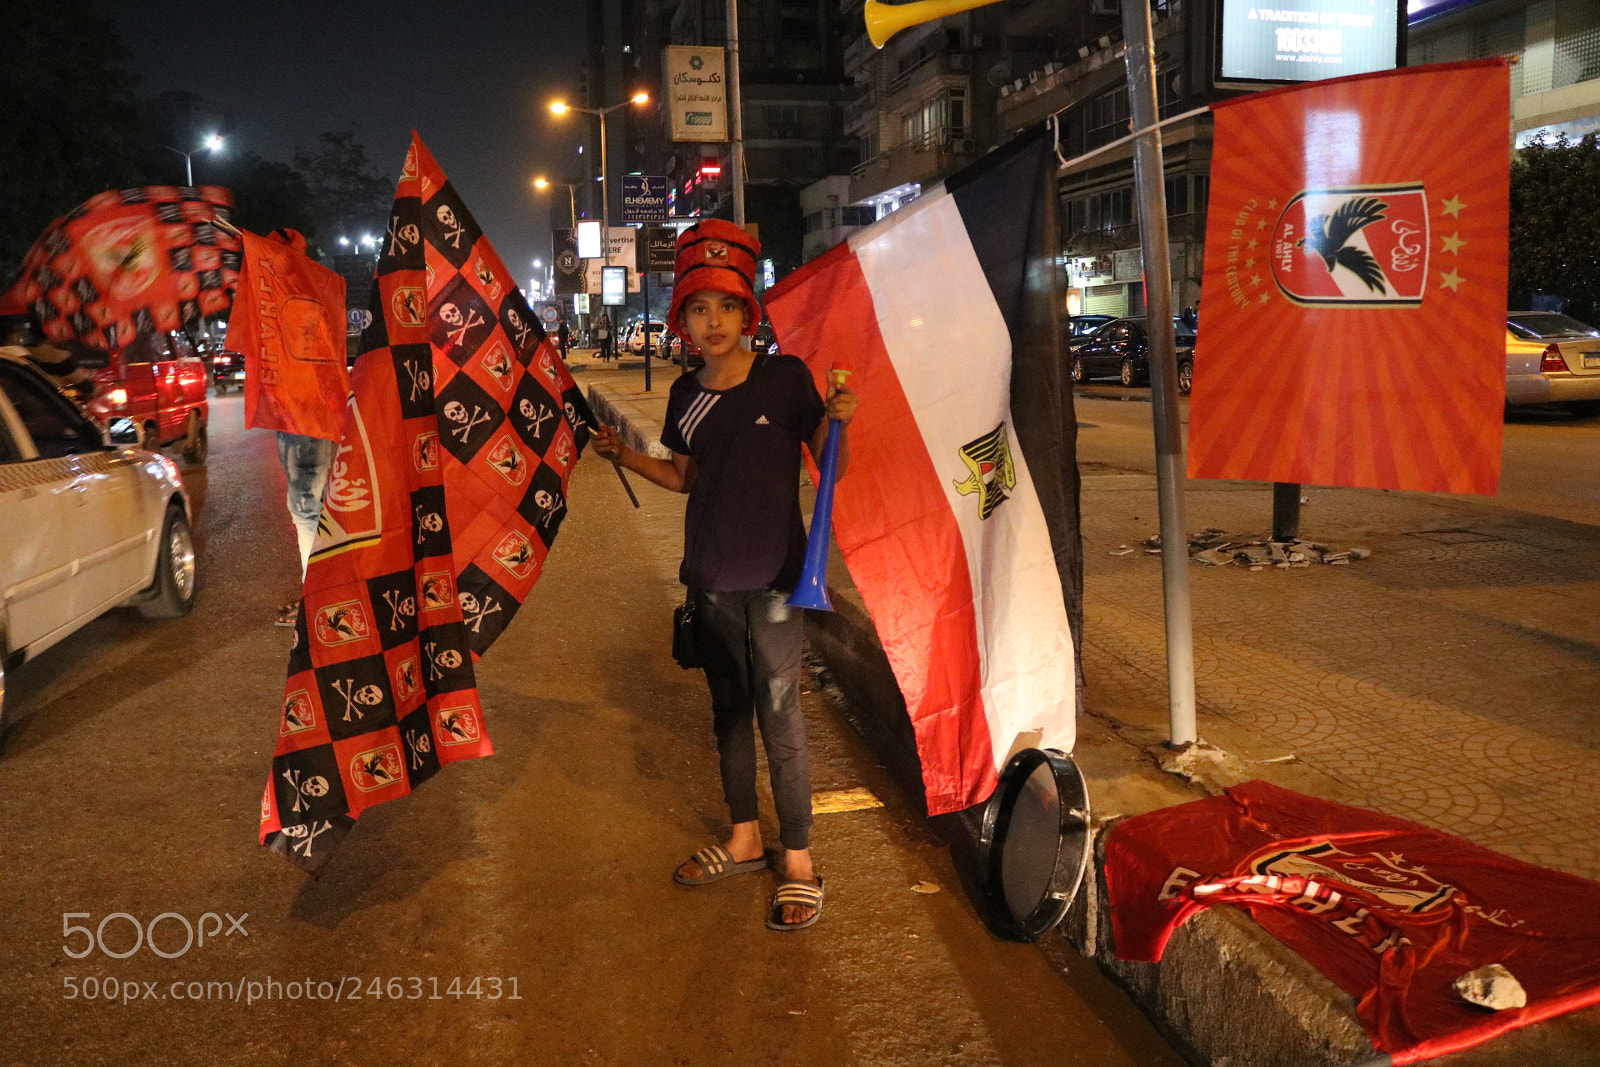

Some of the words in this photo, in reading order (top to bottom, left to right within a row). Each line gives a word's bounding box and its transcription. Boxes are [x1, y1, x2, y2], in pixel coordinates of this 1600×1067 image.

[1248, 8, 1258, 20] A
[1258, 9, 1319, 24] TRADITION
[1275, 54, 1343, 64] www.alahly.com
[1235, 198, 1258, 226] CLUB
[1283, 223, 1294, 239] AL
[1227, 245, 1240, 264] THE
[1281, 241, 1294, 273] AHLY
[1226, 266, 1251, 310] CENTURY
